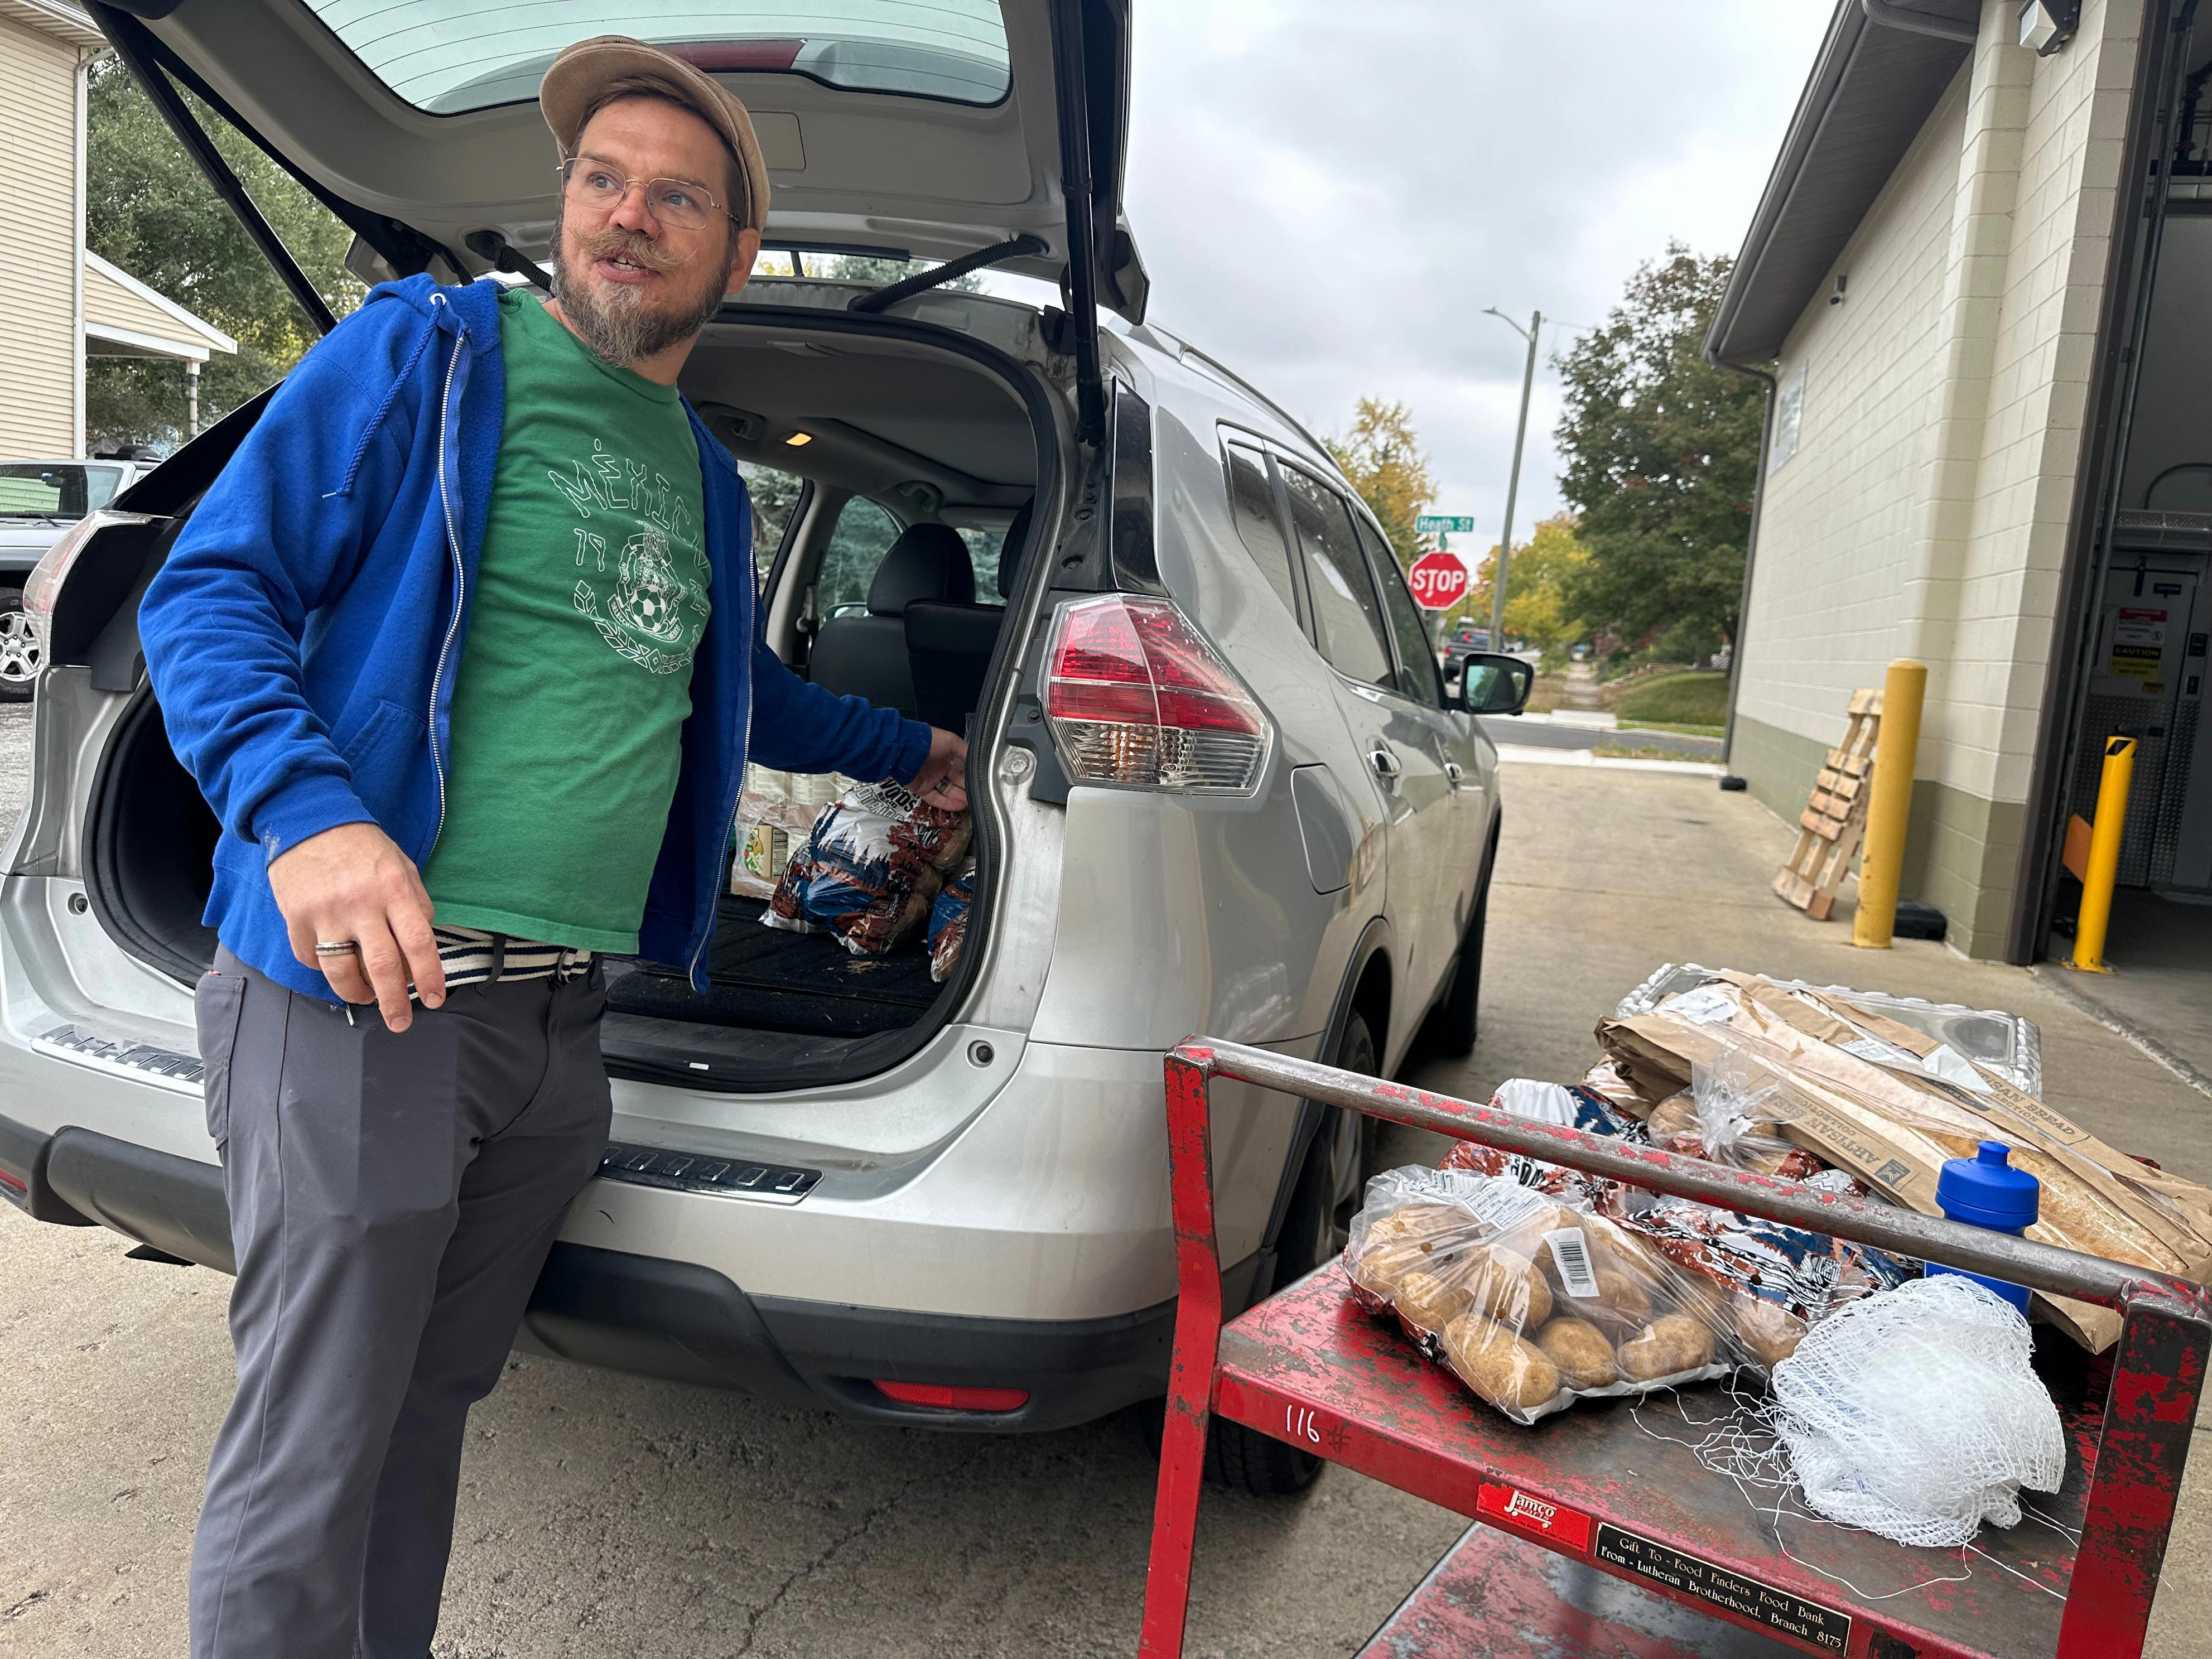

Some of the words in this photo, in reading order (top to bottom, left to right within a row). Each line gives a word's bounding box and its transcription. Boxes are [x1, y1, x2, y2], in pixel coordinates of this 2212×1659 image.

[1419, 518, 1454, 531] Heath
[1458, 519, 1471, 531] St
[1413, 568, 1466, 592] STOP
[2115, 647, 2159, 657] CAUTION
[1766, 1093, 1806, 1120] BREA
[1790, 1094, 1857, 1137] COLLECTION
[1978, 1070, 2025, 1104] TISAN
[2025, 1103, 2075, 1135] BREAD
[1992, 1092, 2040, 1122] LECTION
[1804, 1117, 1881, 1166] ARTISAN
[1286, 1404, 1320, 1443] 116
[1504, 1489, 1555, 1518] Jamco
[1601, 1545, 1626, 1565] From
[1637, 1560, 1680, 1586] Lutheran
[1688, 1579, 1761, 1619] Brotherhood,
[1770, 1612, 1808, 1636] Branch
[1816, 1630, 1842, 1648] 8175
[1619, 1537, 1640, 1555] Gift
[1648, 1547, 1662, 1562] To
[1674, 1557, 1703, 1578] Food
[1710, 1572, 1751, 1597] Finders
[1759, 1591, 1789, 1612] Food
[1797, 1605, 1825, 1626] Bank
